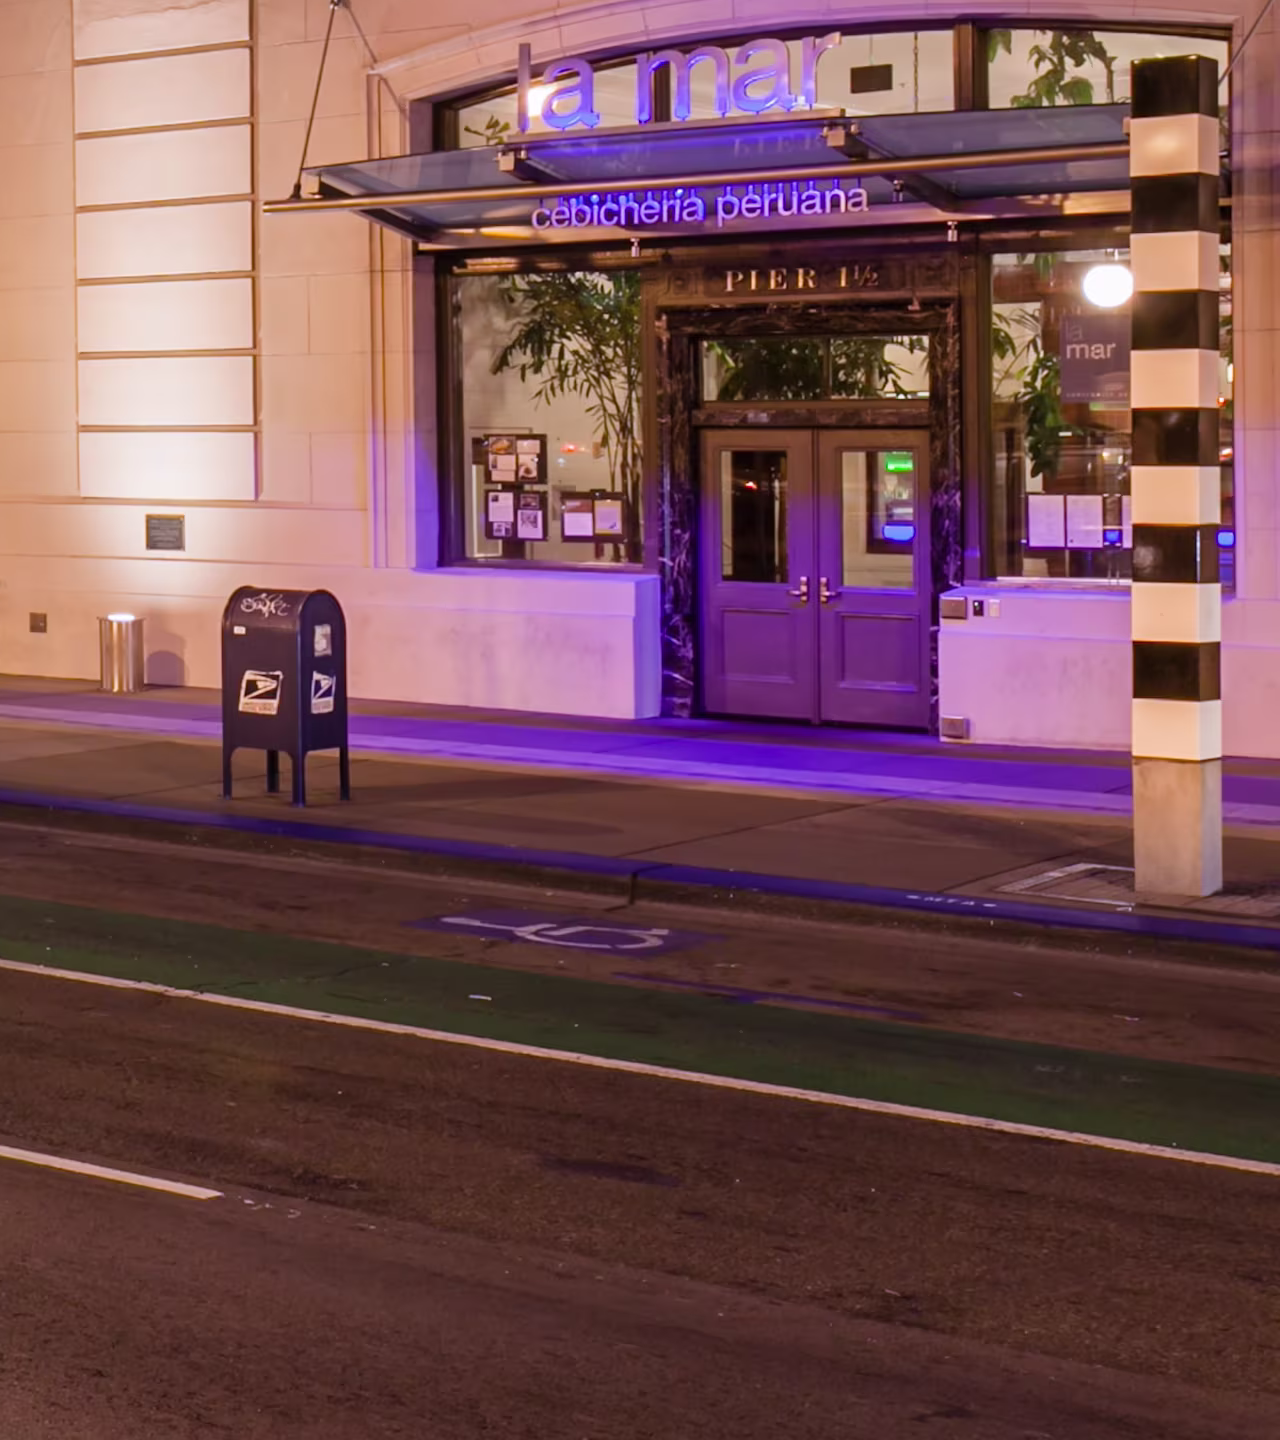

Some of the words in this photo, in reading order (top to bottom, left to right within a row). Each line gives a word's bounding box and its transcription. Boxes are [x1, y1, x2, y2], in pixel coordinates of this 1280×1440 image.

[518, 43, 600, 131] la
[635, 31, 841, 122] mar
[716, 187, 869, 228] peruana
[724, 267, 817, 292] PIER
[1066, 342, 1117, 359] mar
